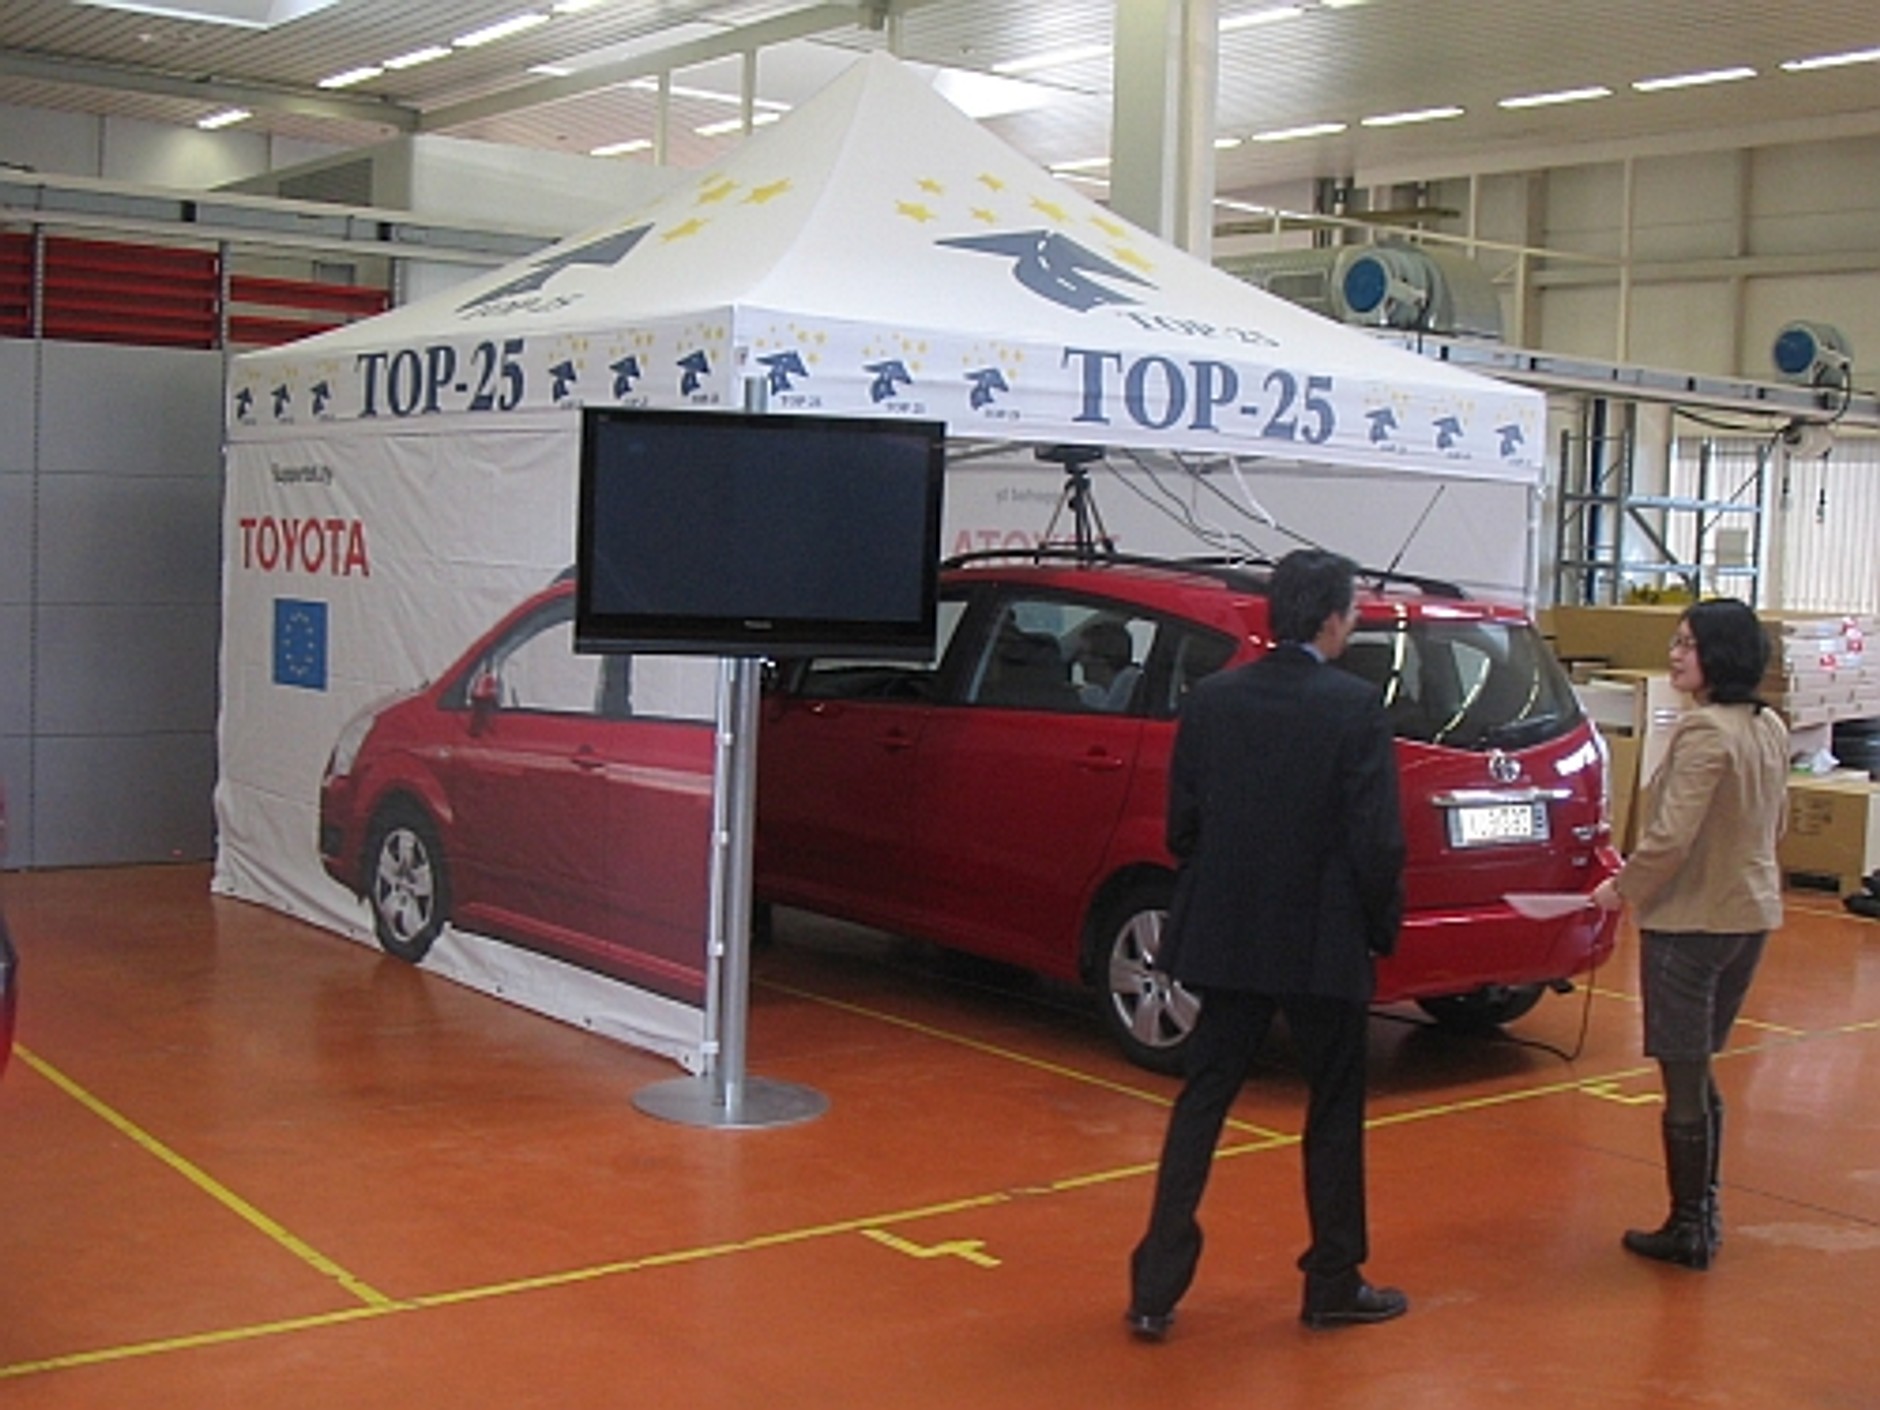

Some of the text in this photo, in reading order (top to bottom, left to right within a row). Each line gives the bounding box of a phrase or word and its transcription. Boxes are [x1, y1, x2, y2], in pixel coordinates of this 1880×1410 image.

[357, 338, 525, 418] TOP-25
[1061, 346, 1336, 445] TOP-25
[239, 516, 370, 578] TOYOTA
